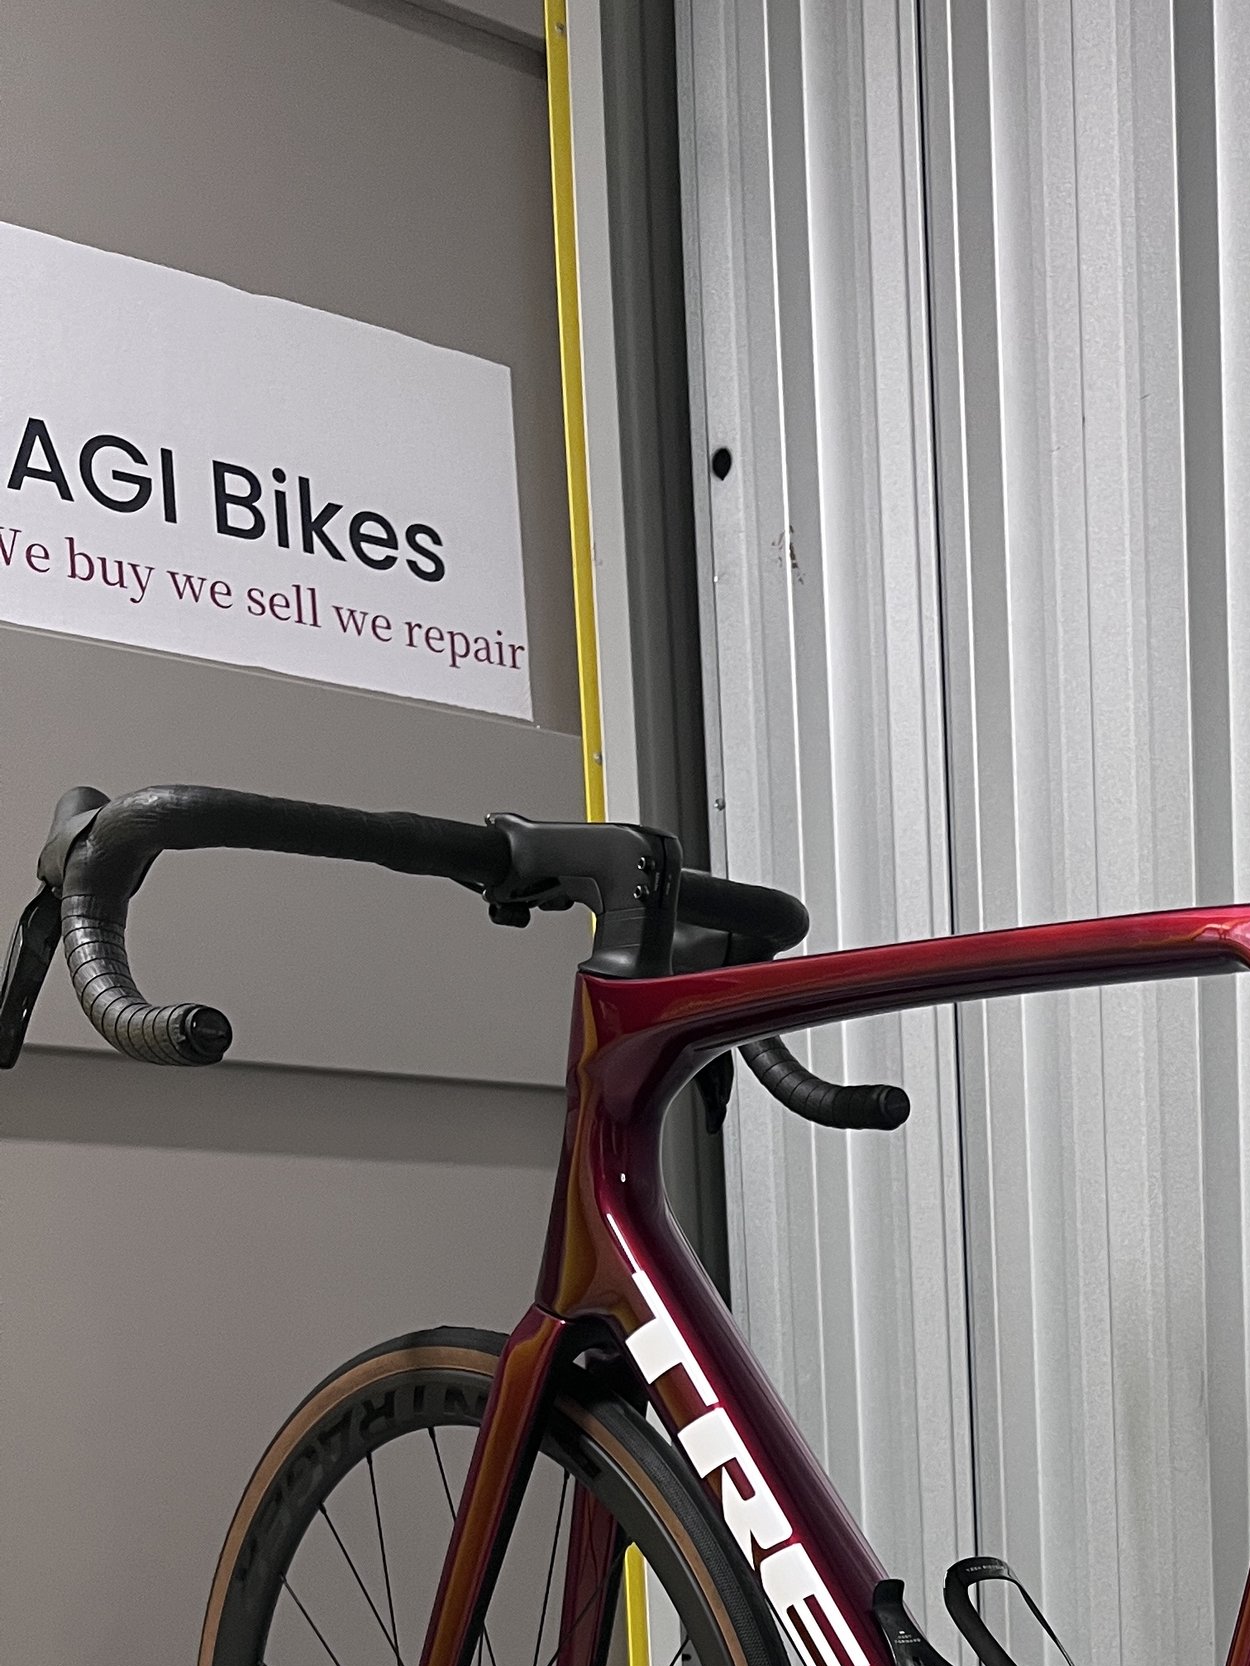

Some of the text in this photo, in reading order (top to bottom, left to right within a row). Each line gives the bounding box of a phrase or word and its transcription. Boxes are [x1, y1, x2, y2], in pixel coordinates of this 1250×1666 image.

[7, 417, 446, 583] AGI Bikes
[65, 537, 155, 604] buy
[167, 570, 234, 609] we
[247, 584, 322, 628] sell
[331, 605, 393, 642] we
[404, 620, 526, 669] repair
